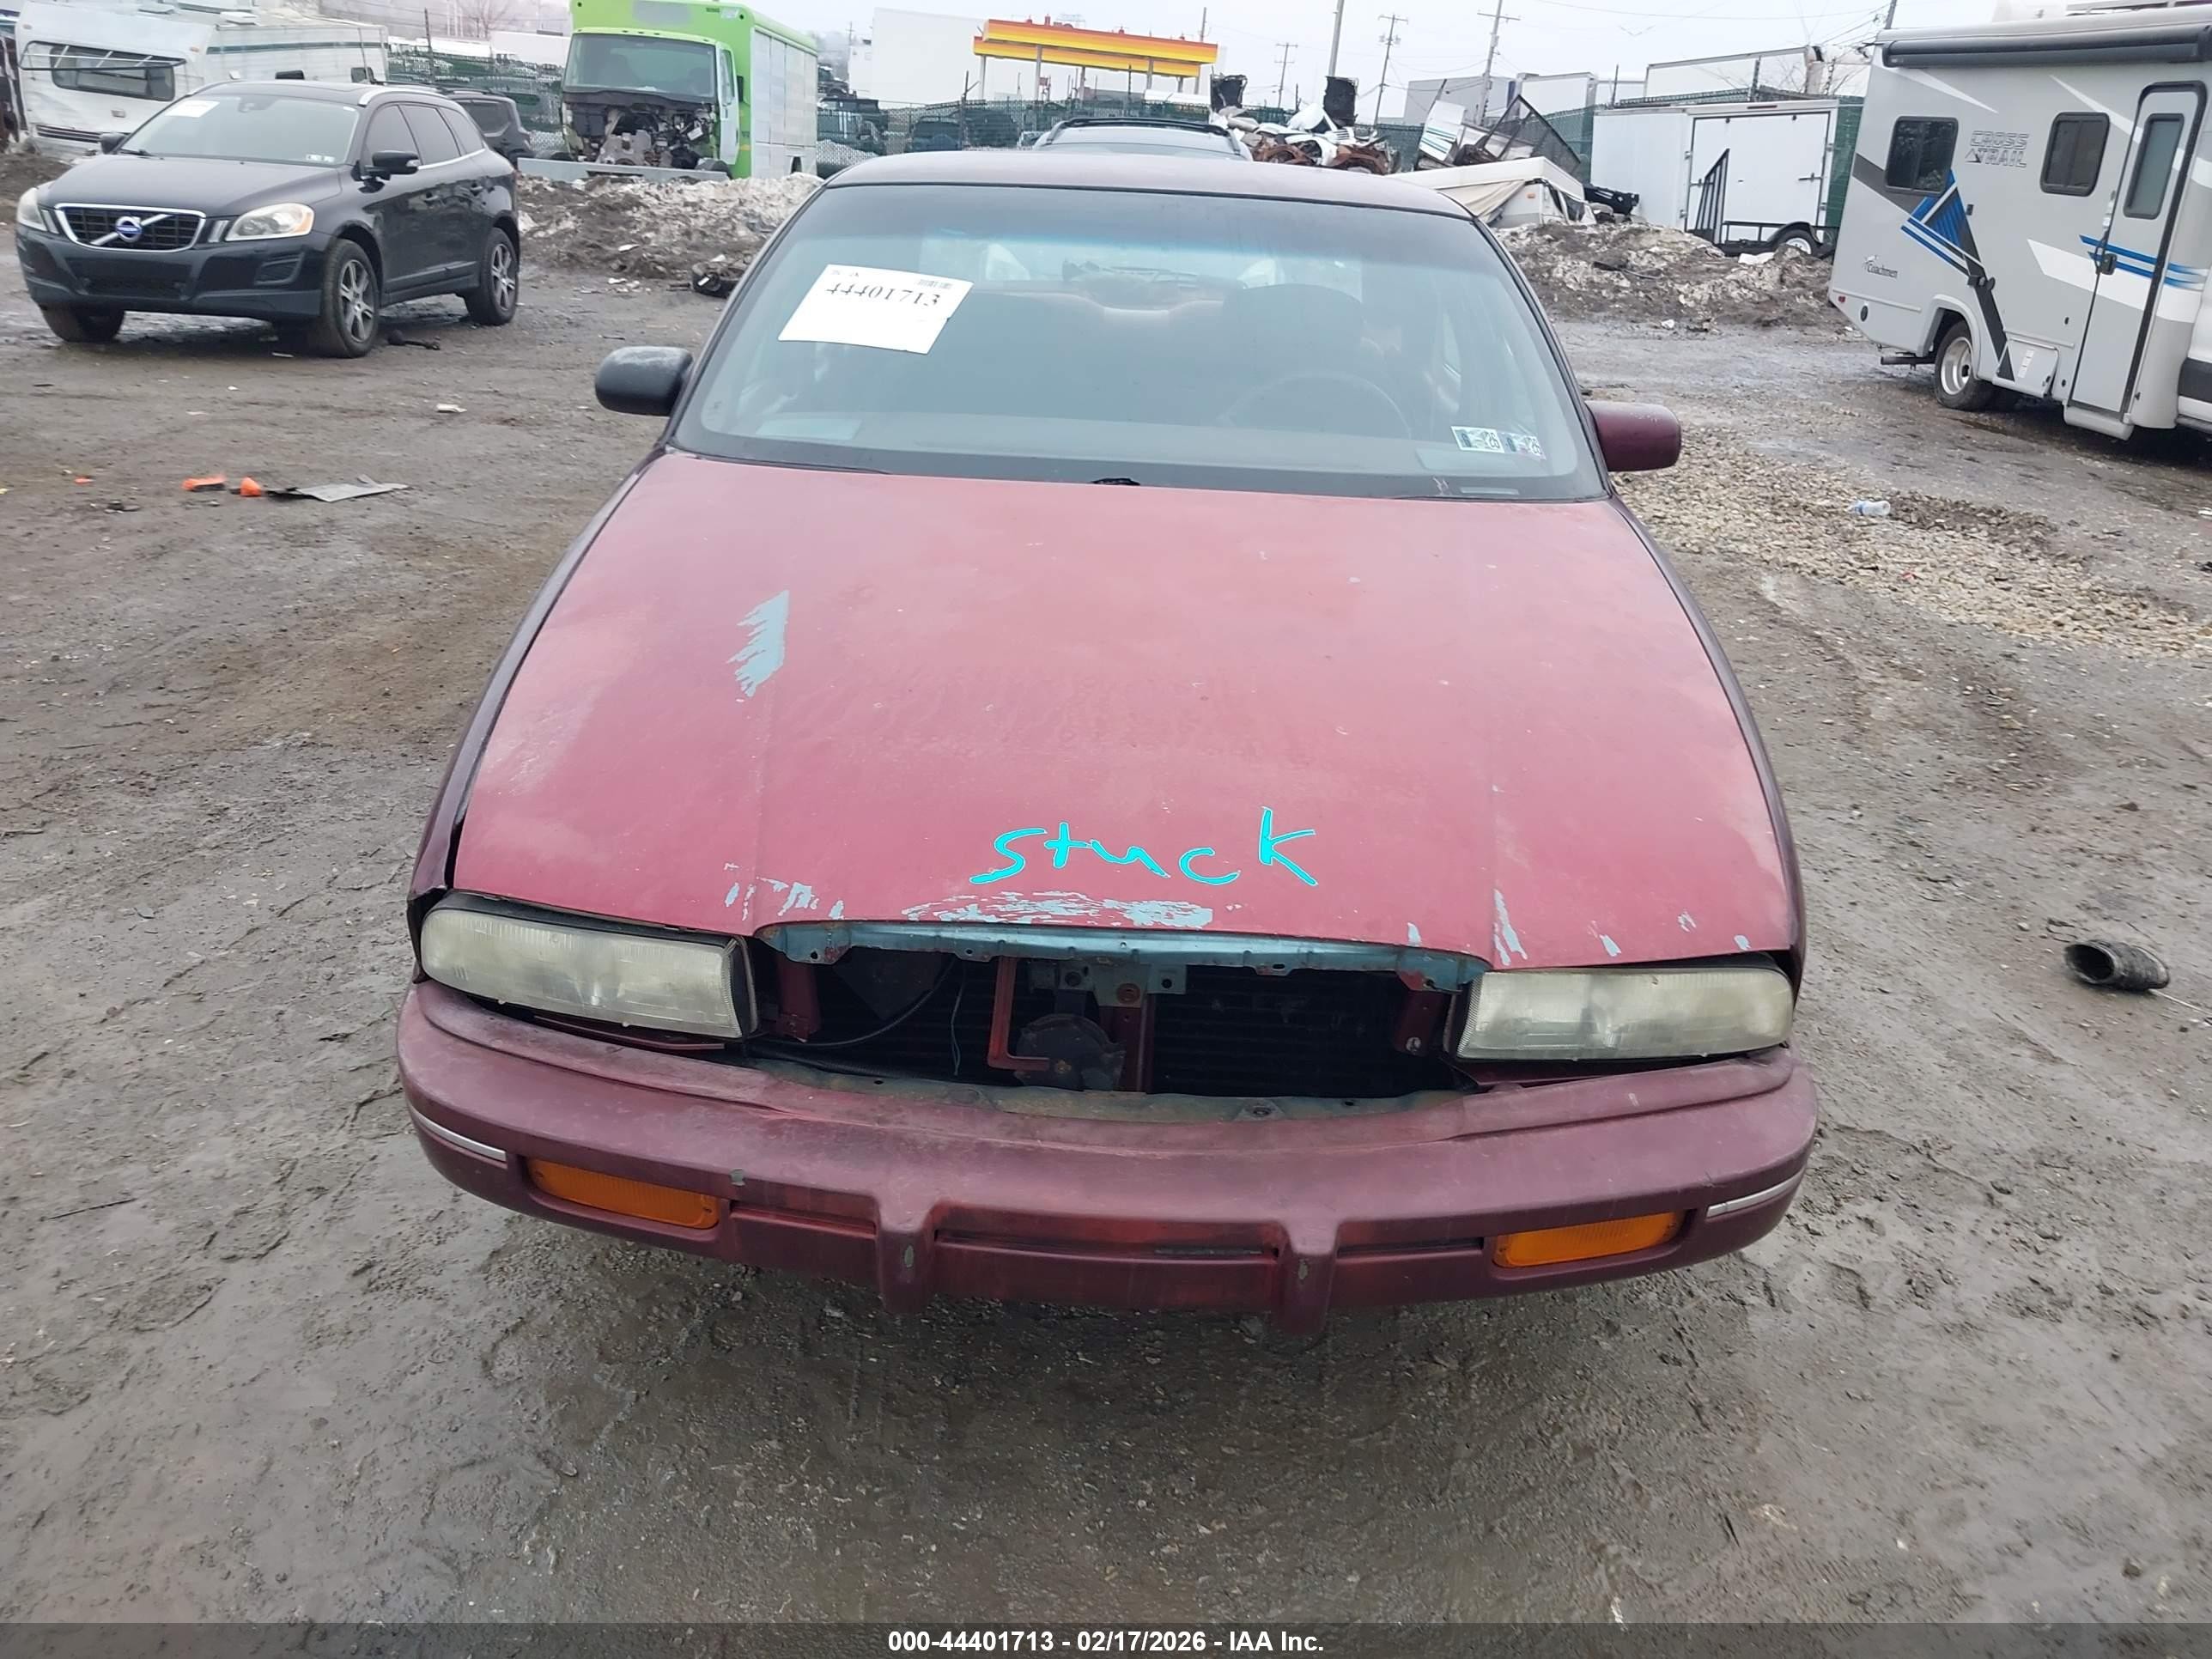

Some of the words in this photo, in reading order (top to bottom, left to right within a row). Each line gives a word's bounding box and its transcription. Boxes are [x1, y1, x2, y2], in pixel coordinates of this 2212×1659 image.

[1970, 131, 2030, 150] CROSS
[1977, 147, 2027, 167] TRAIL
[825, 282, 941, 307] 44401713
